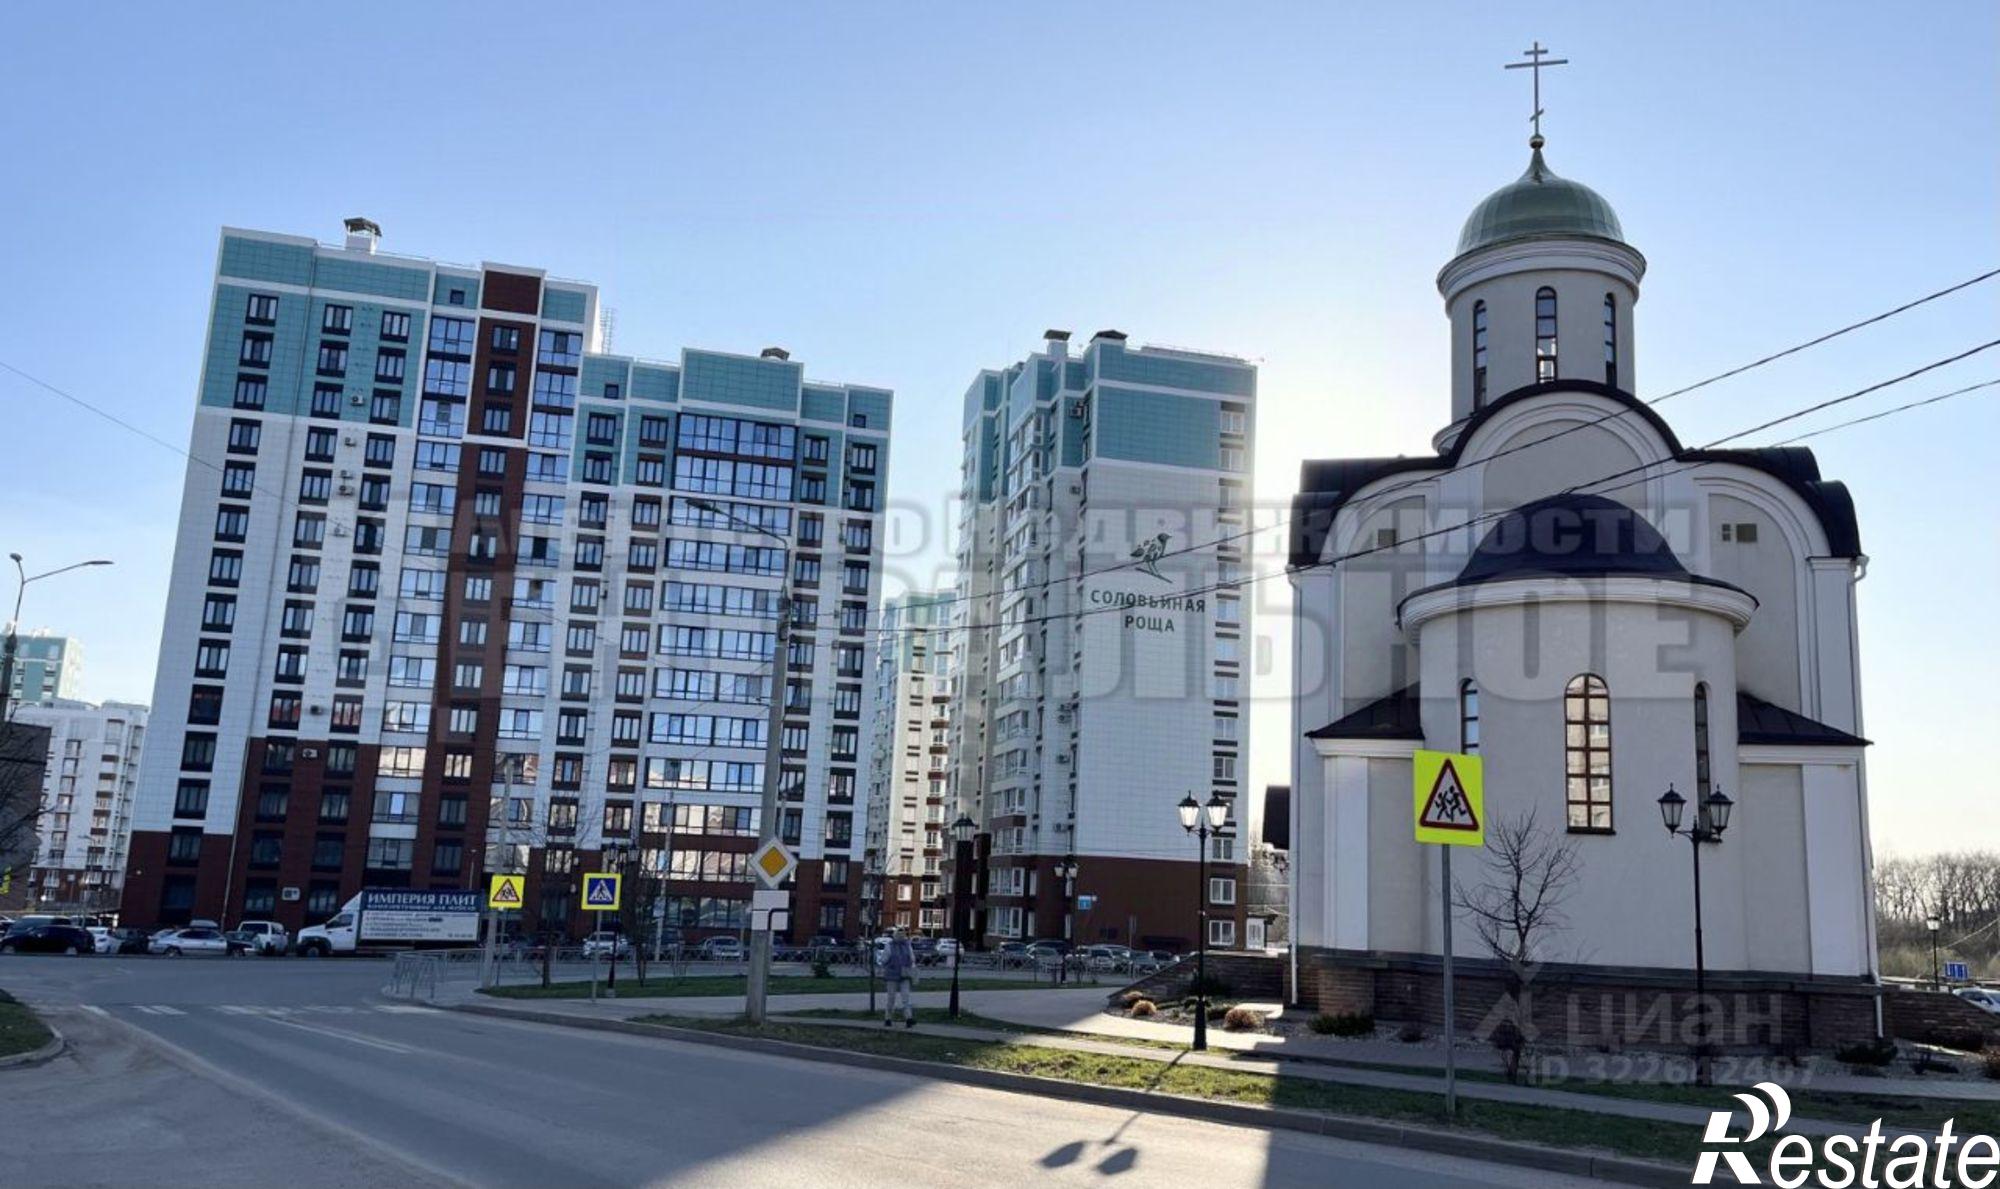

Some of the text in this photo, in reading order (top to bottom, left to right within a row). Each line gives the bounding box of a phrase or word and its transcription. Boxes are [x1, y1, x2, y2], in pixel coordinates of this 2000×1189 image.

[1091, 590, 1205, 612] СОЛОВЬИНАЯ
[1124, 615, 1174, 632] РОЩА
[368, 892, 436, 904] ИМПЕРИЯ
